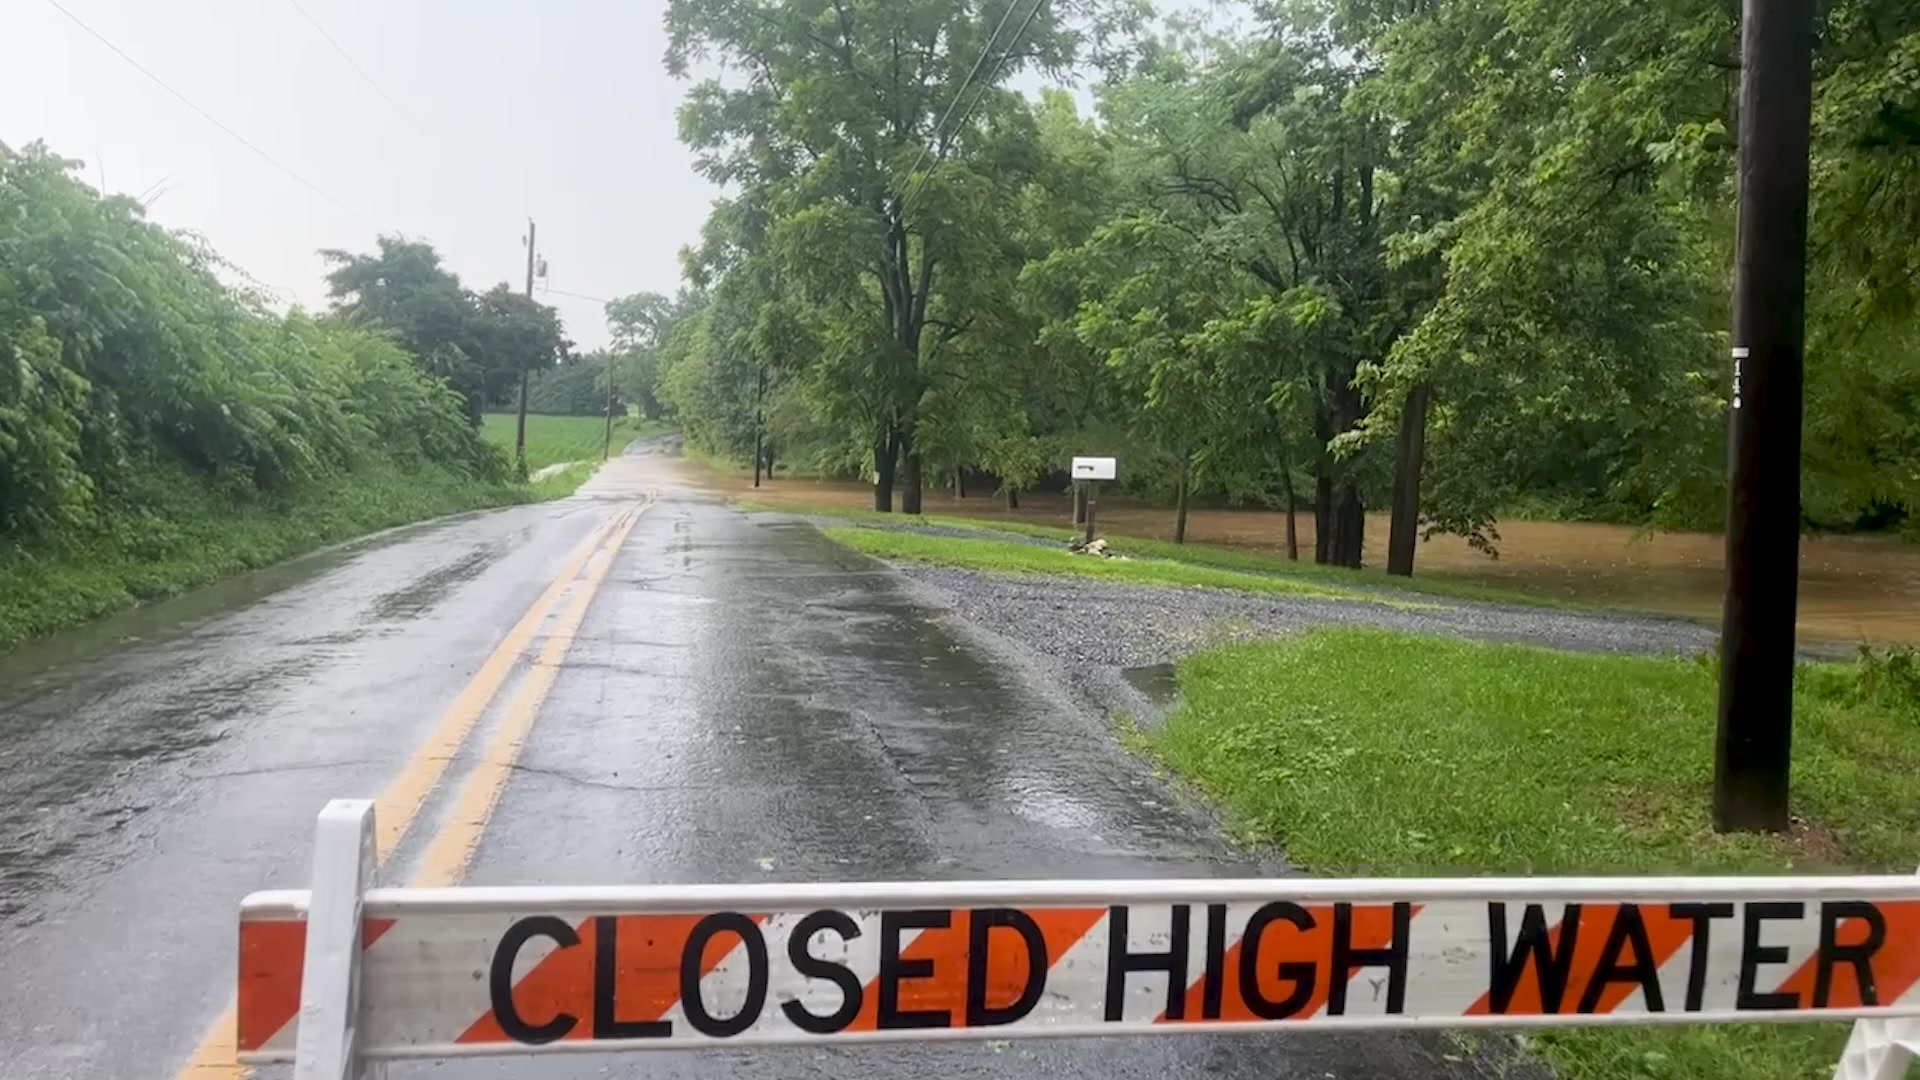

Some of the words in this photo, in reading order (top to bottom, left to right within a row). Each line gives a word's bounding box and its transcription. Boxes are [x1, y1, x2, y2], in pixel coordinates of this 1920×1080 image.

[491, 909, 1048, 1043] CLOSED
[1104, 902, 1411, 1022] HIGH
[1488, 901, 1886, 1013] WATER
